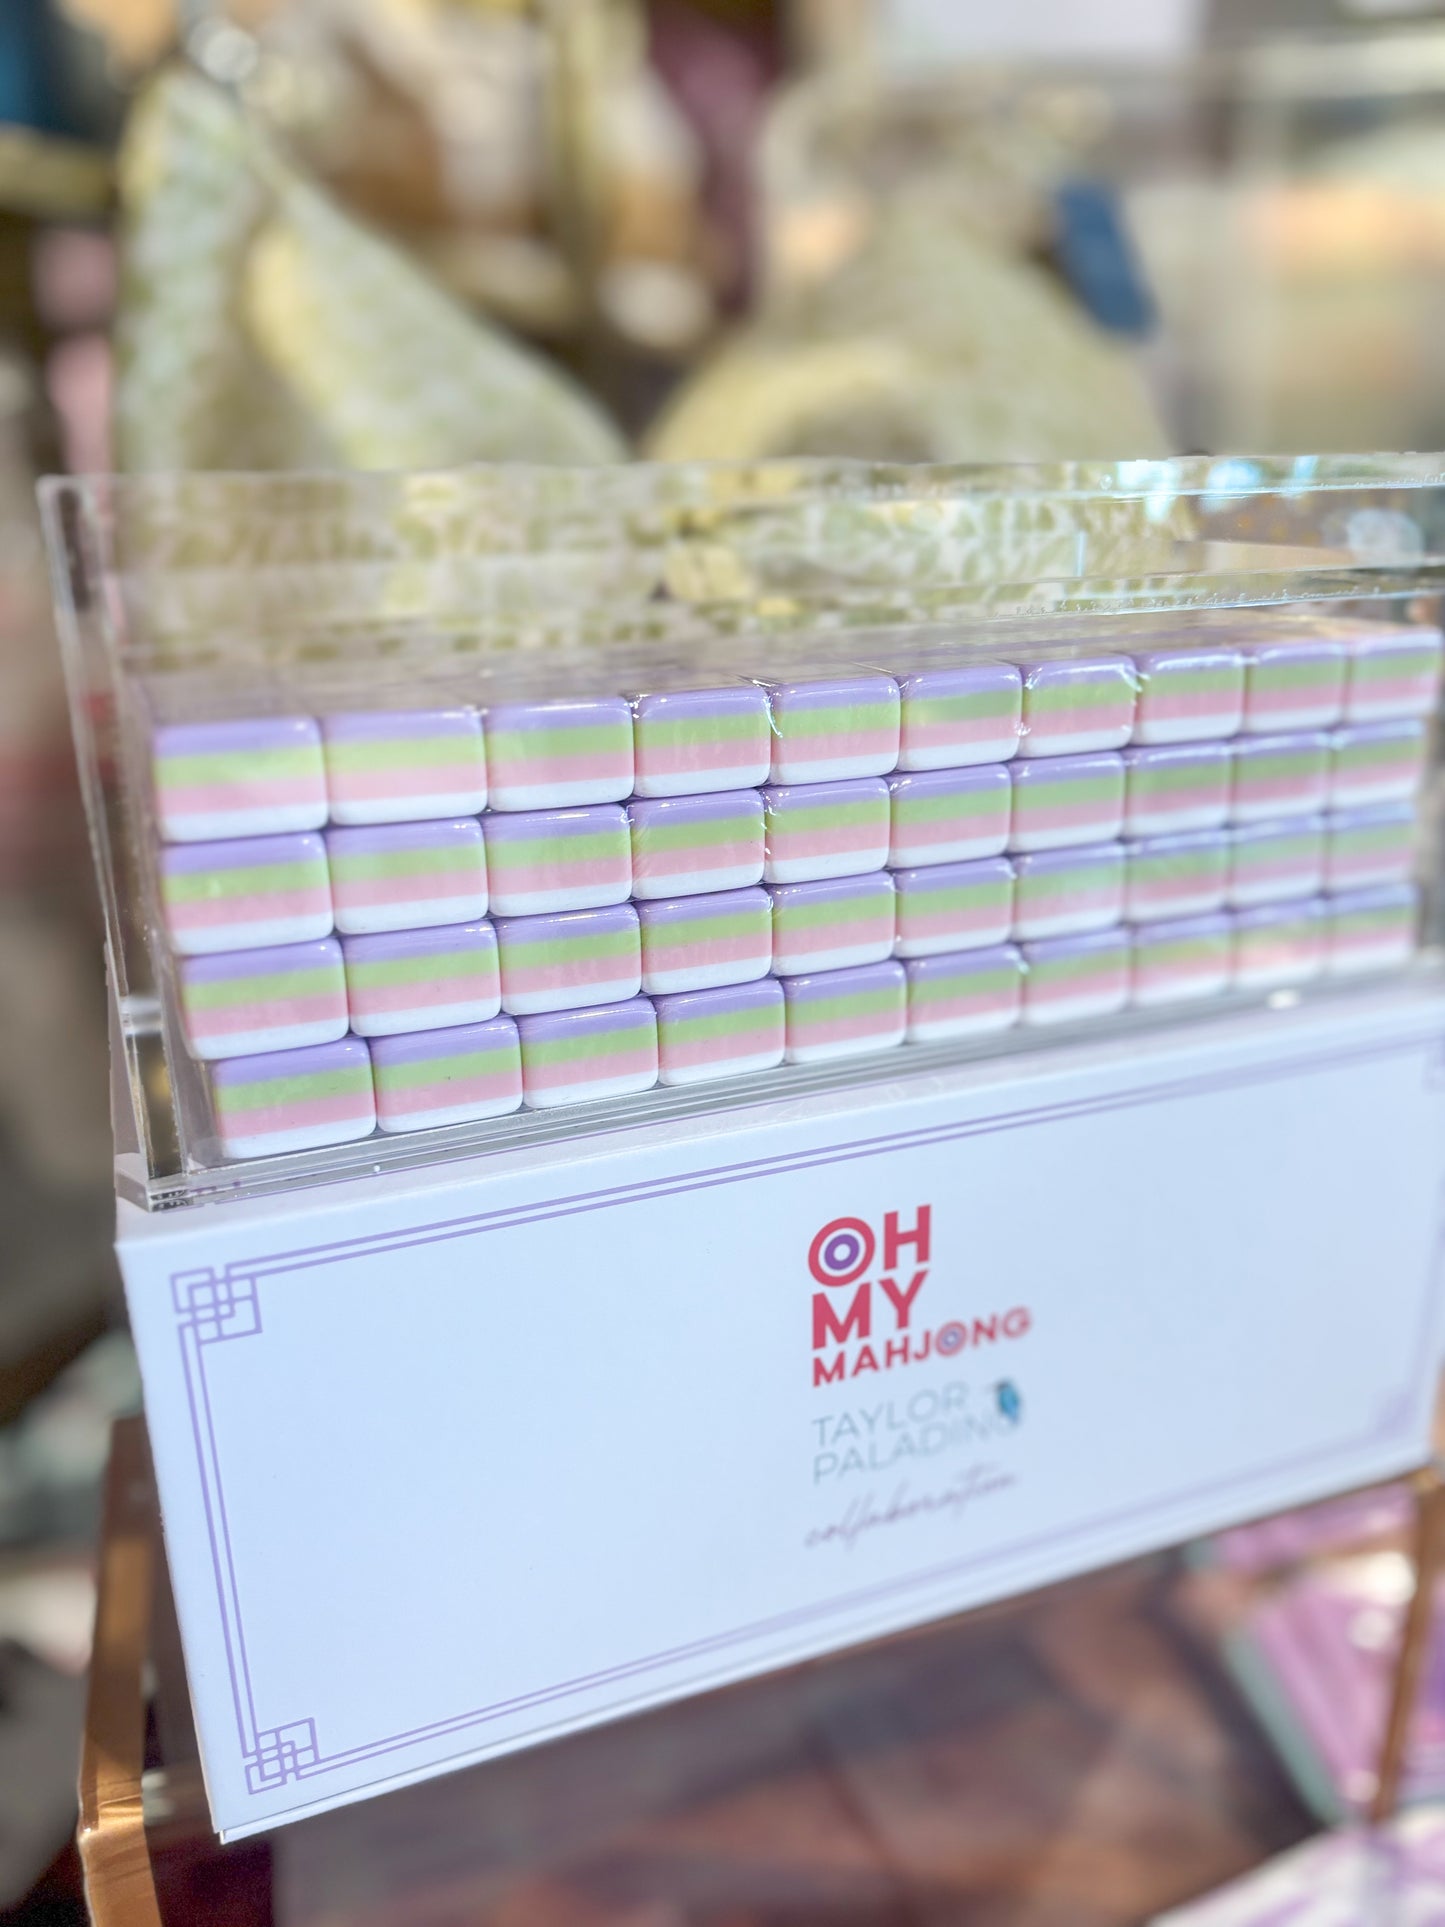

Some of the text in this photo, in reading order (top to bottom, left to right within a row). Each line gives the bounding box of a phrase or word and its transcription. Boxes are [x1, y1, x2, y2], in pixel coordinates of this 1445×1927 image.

[808, 1204, 931, 1287] OH
[812, 1269, 929, 1350] MY
[813, 1306, 1032, 1387] MAHJONG
[812, 1380, 970, 1448] TAYLOR
[804, 1459, 1019, 1550] collaboration
